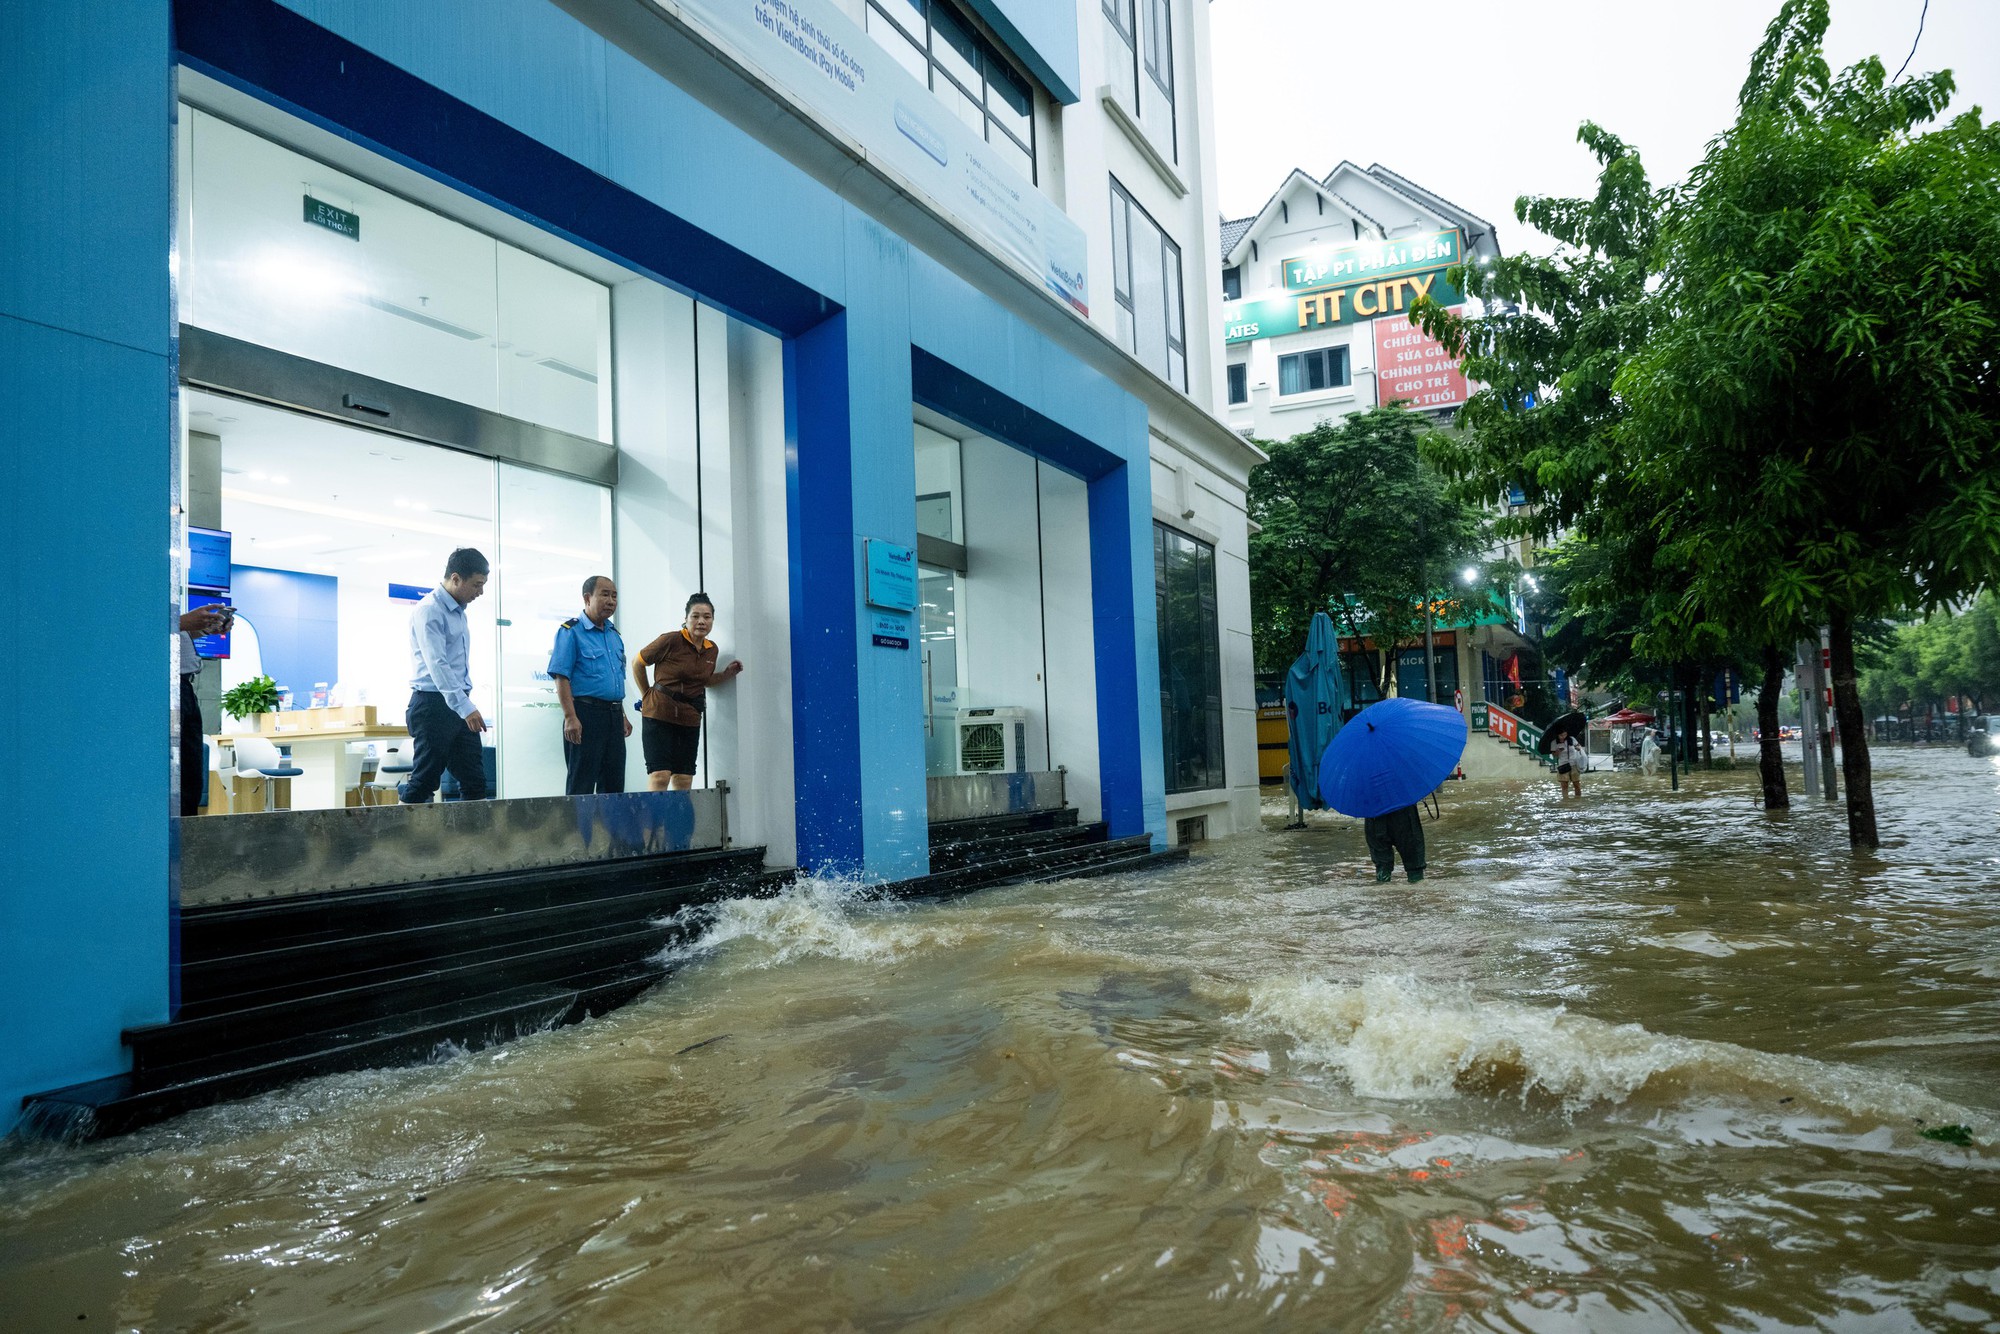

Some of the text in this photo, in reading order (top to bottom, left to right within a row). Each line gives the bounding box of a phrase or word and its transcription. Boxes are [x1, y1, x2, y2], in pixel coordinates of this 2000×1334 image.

[754, 4, 855, 92] trên VietinBank iPay Mobile
[788, 4, 799, 30] hệ
[800, 17, 816, 40] sinh
[816, 28, 831, 52] thái
[831, 42, 840, 59] số
[840, 48, 849, 67] đa
[850, 56, 865, 83] dạng
[318, 204, 347, 223] EXIT
[1293, 234, 1453, 286] TẬP PT PHẢI ĐẾN
[1298, 272, 1437, 328] FIT CITY
[1425, 358, 1463, 374] DÁNG
[1395, 380, 1424, 393] CHO
[1400, 656, 1425, 666] KICK
[1489, 711, 1514, 737] FIT
